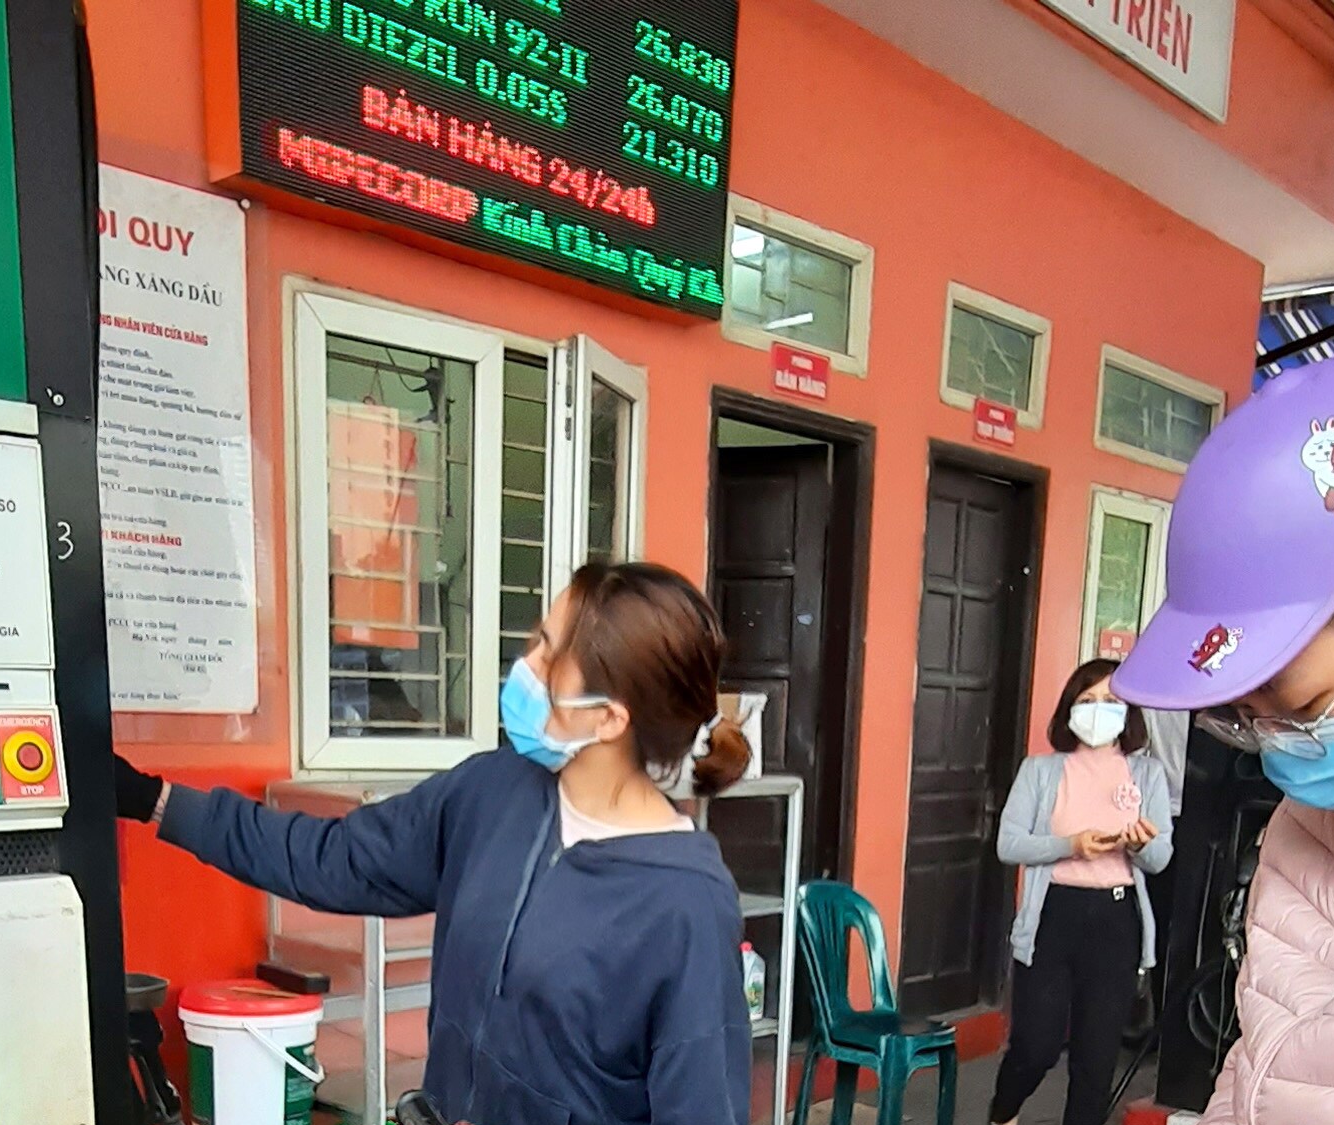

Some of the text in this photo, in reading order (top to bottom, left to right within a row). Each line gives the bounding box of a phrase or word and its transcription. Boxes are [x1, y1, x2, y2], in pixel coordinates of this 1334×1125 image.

[342, 2, 467, 85] DIEZEL
[626, 74, 724, 142] 26.070
[504, 18, 589, 85] 92-II
[634, 19, 731, 92] 26.830
[622, 121, 718, 187] 21.310
[128, 216, 195, 257] QUY
[57, 521, 74, 560] 3
